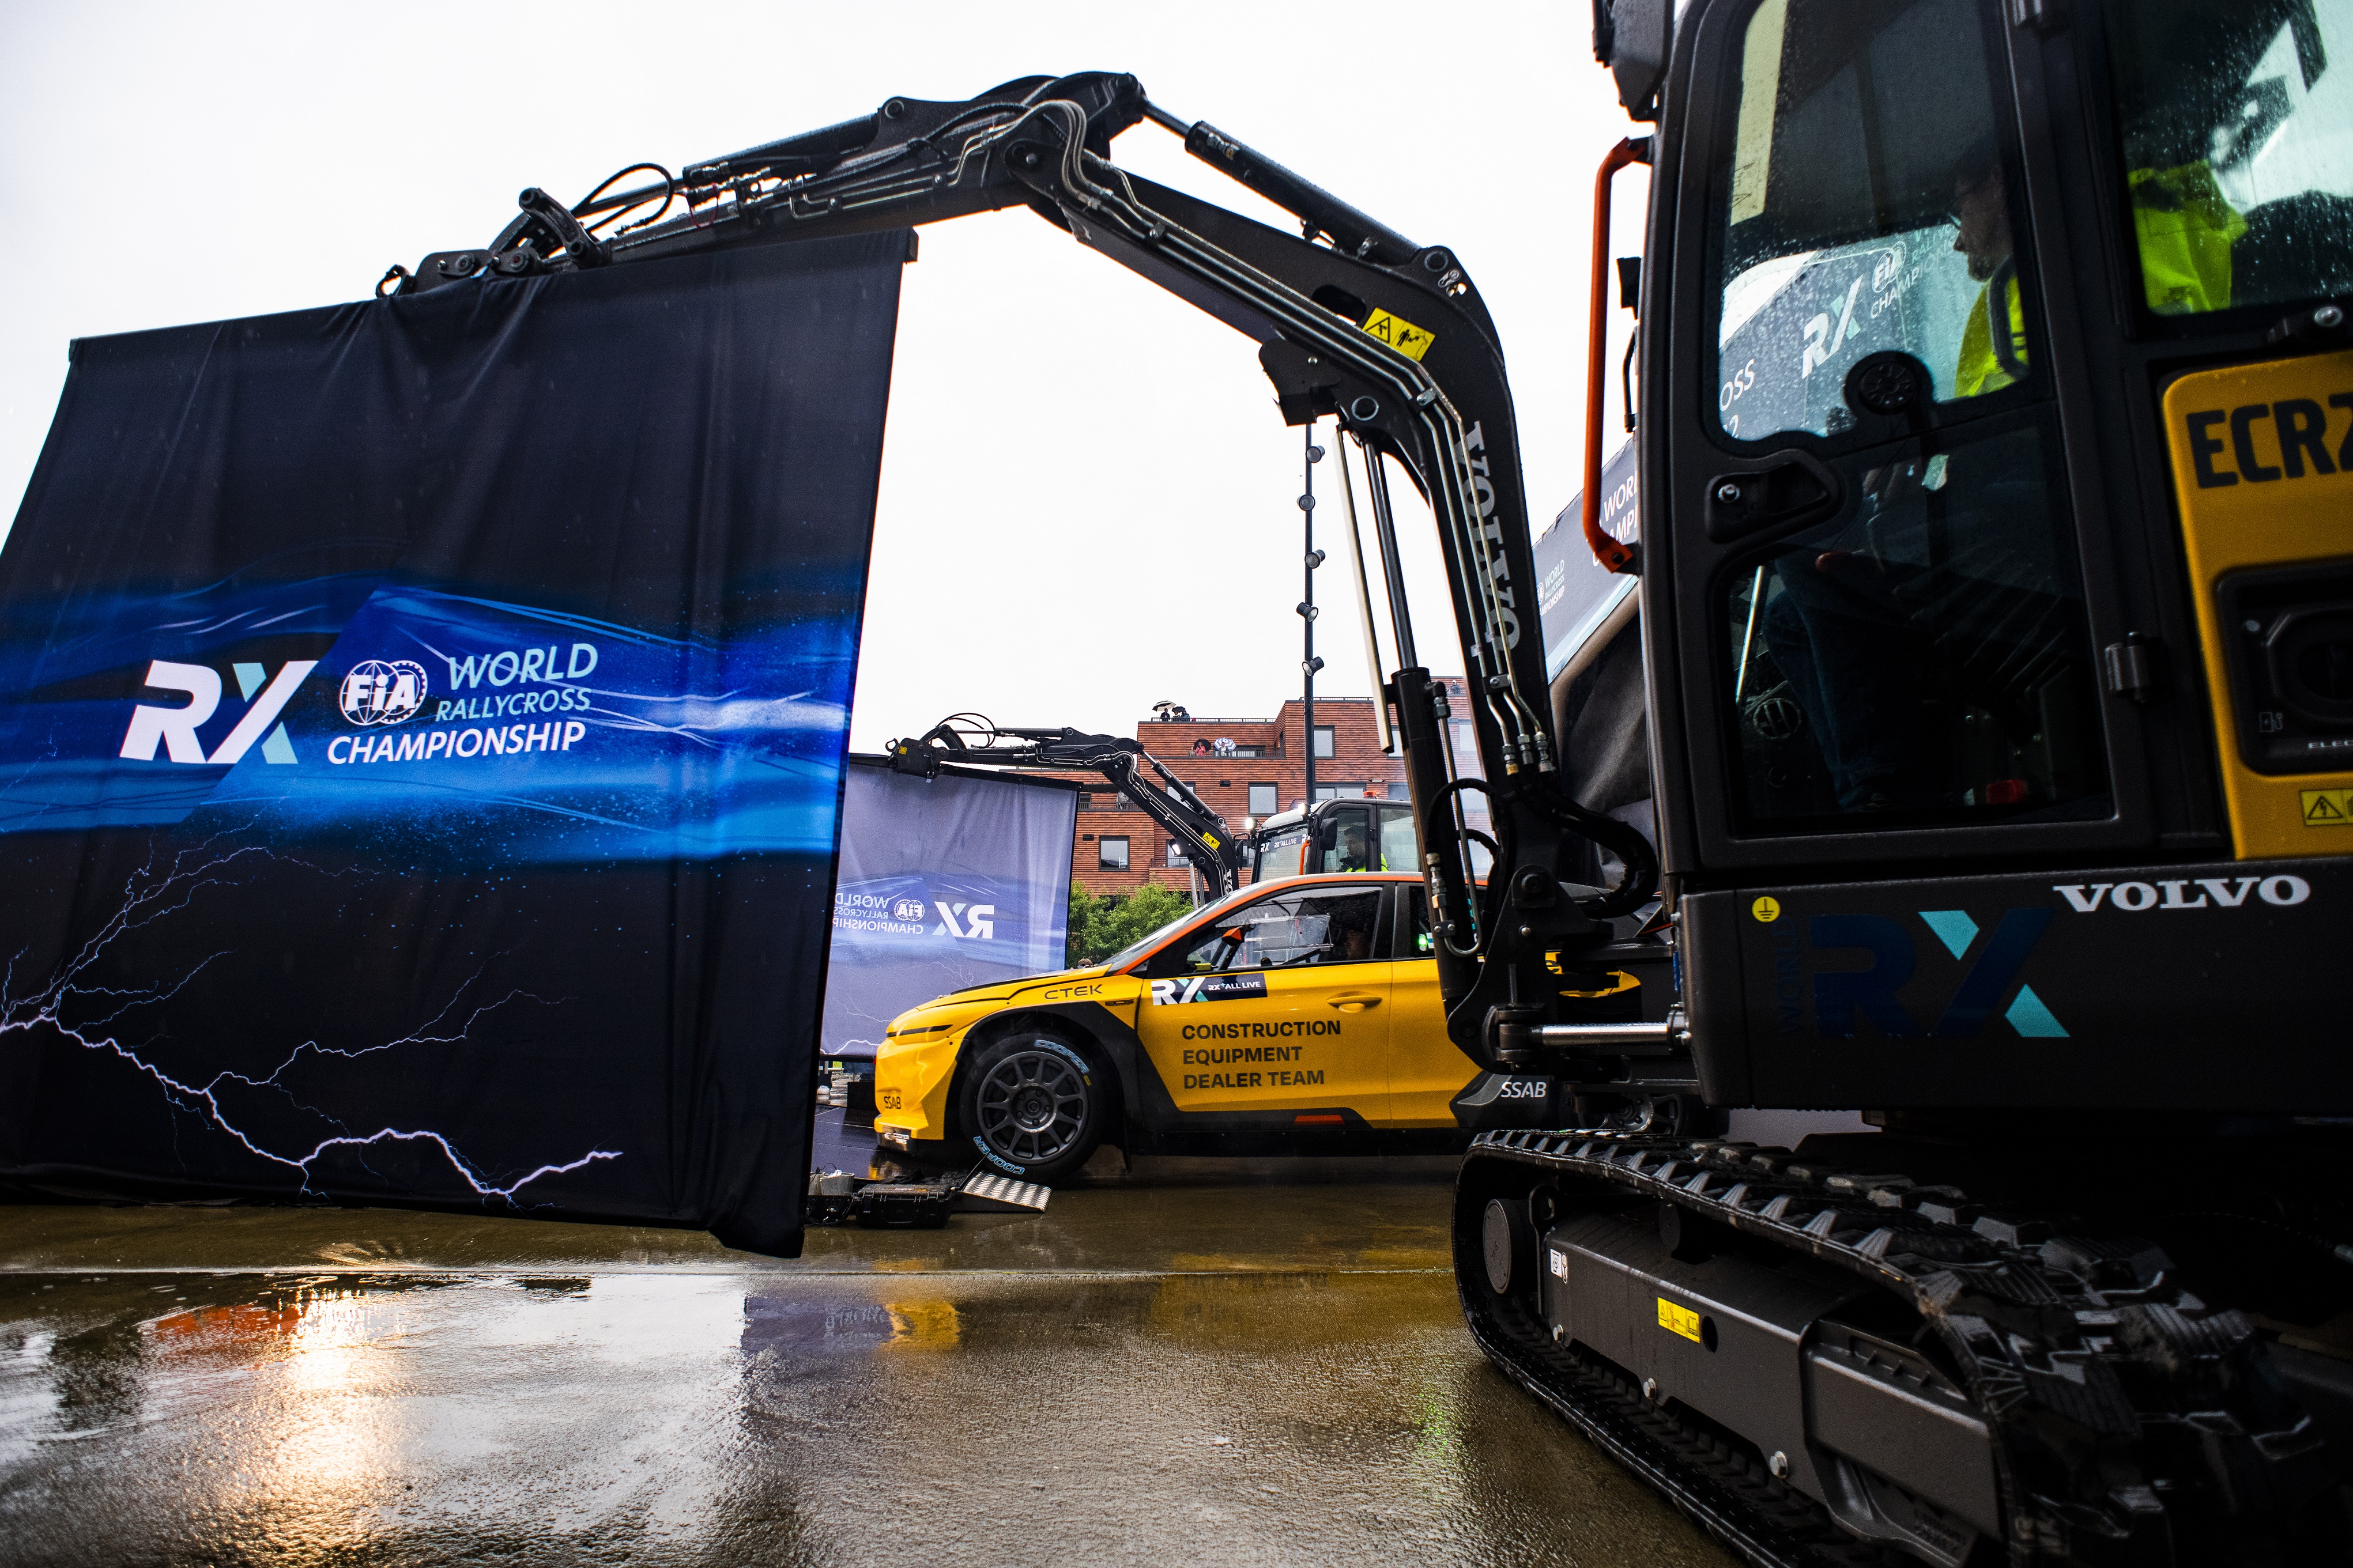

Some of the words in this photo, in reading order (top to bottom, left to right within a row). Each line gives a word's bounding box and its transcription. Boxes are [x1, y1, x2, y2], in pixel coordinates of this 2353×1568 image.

[1802, 274, 1864, 379] RX
[1454, 421, 1520, 652] VOLVO
[1544, 559, 1565, 589] WORLD
[1544, 574, 1565, 600] RALLYCROSS
[448, 643, 598, 690] WORLD
[119, 659, 319, 765] RX
[435, 688, 591, 721] RALLYCROSS
[327, 721, 586, 765] CHAMPIONSHIP
[2053, 875, 2310, 912] VOLVO
[1810, 908, 2071, 1038] RX
[1044, 984, 1103, 1000] CTEK
[1151, 976, 1209, 1006] RX
[1182, 1020, 1341, 1040] CONSTRUCTION
[1034, 1039, 1090, 1074] COOPER
[1183, 1046, 1303, 1065] EQUIPMENT
[1184, 1072, 1262, 1089] DEALER
[1267, 1070, 1325, 1087] TEAM
[1500, 1082, 1547, 1098] SSAB
[884, 1096, 901, 1109] SSAB
[972, 1135, 1025, 1175] COOPER
